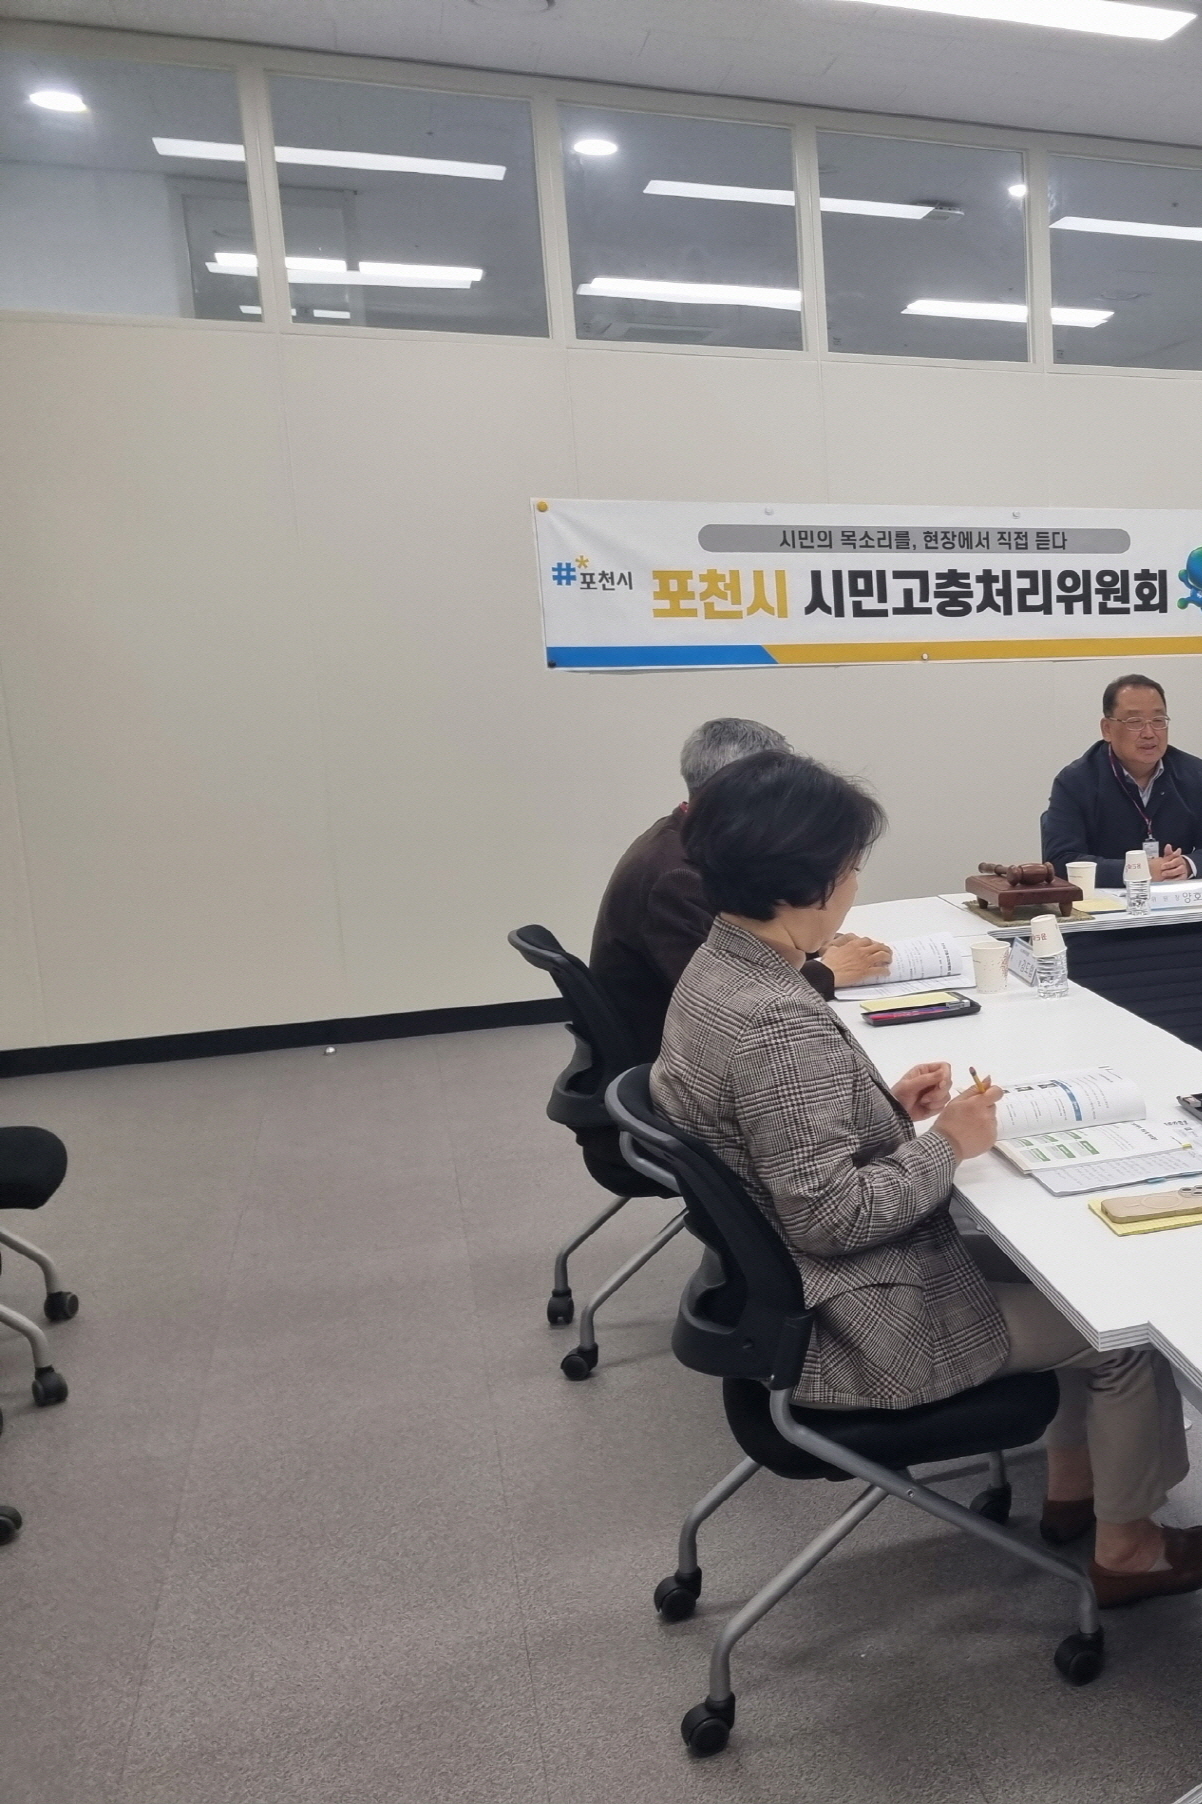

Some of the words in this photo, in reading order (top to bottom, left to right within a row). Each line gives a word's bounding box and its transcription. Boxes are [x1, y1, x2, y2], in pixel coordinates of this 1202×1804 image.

[779, 530, 833, 549] 시민의
[840, 530, 917, 552] 목소리를,
[922, 530, 990, 550] 현장에서
[997, 531, 1029, 551] 직접
[1035, 531, 1068, 551] 듣다
[580, 570, 633, 591] 포천시
[653, 568, 788, 619] 포천시
[804, 567, 1168, 618] 시민고충처리위원회
